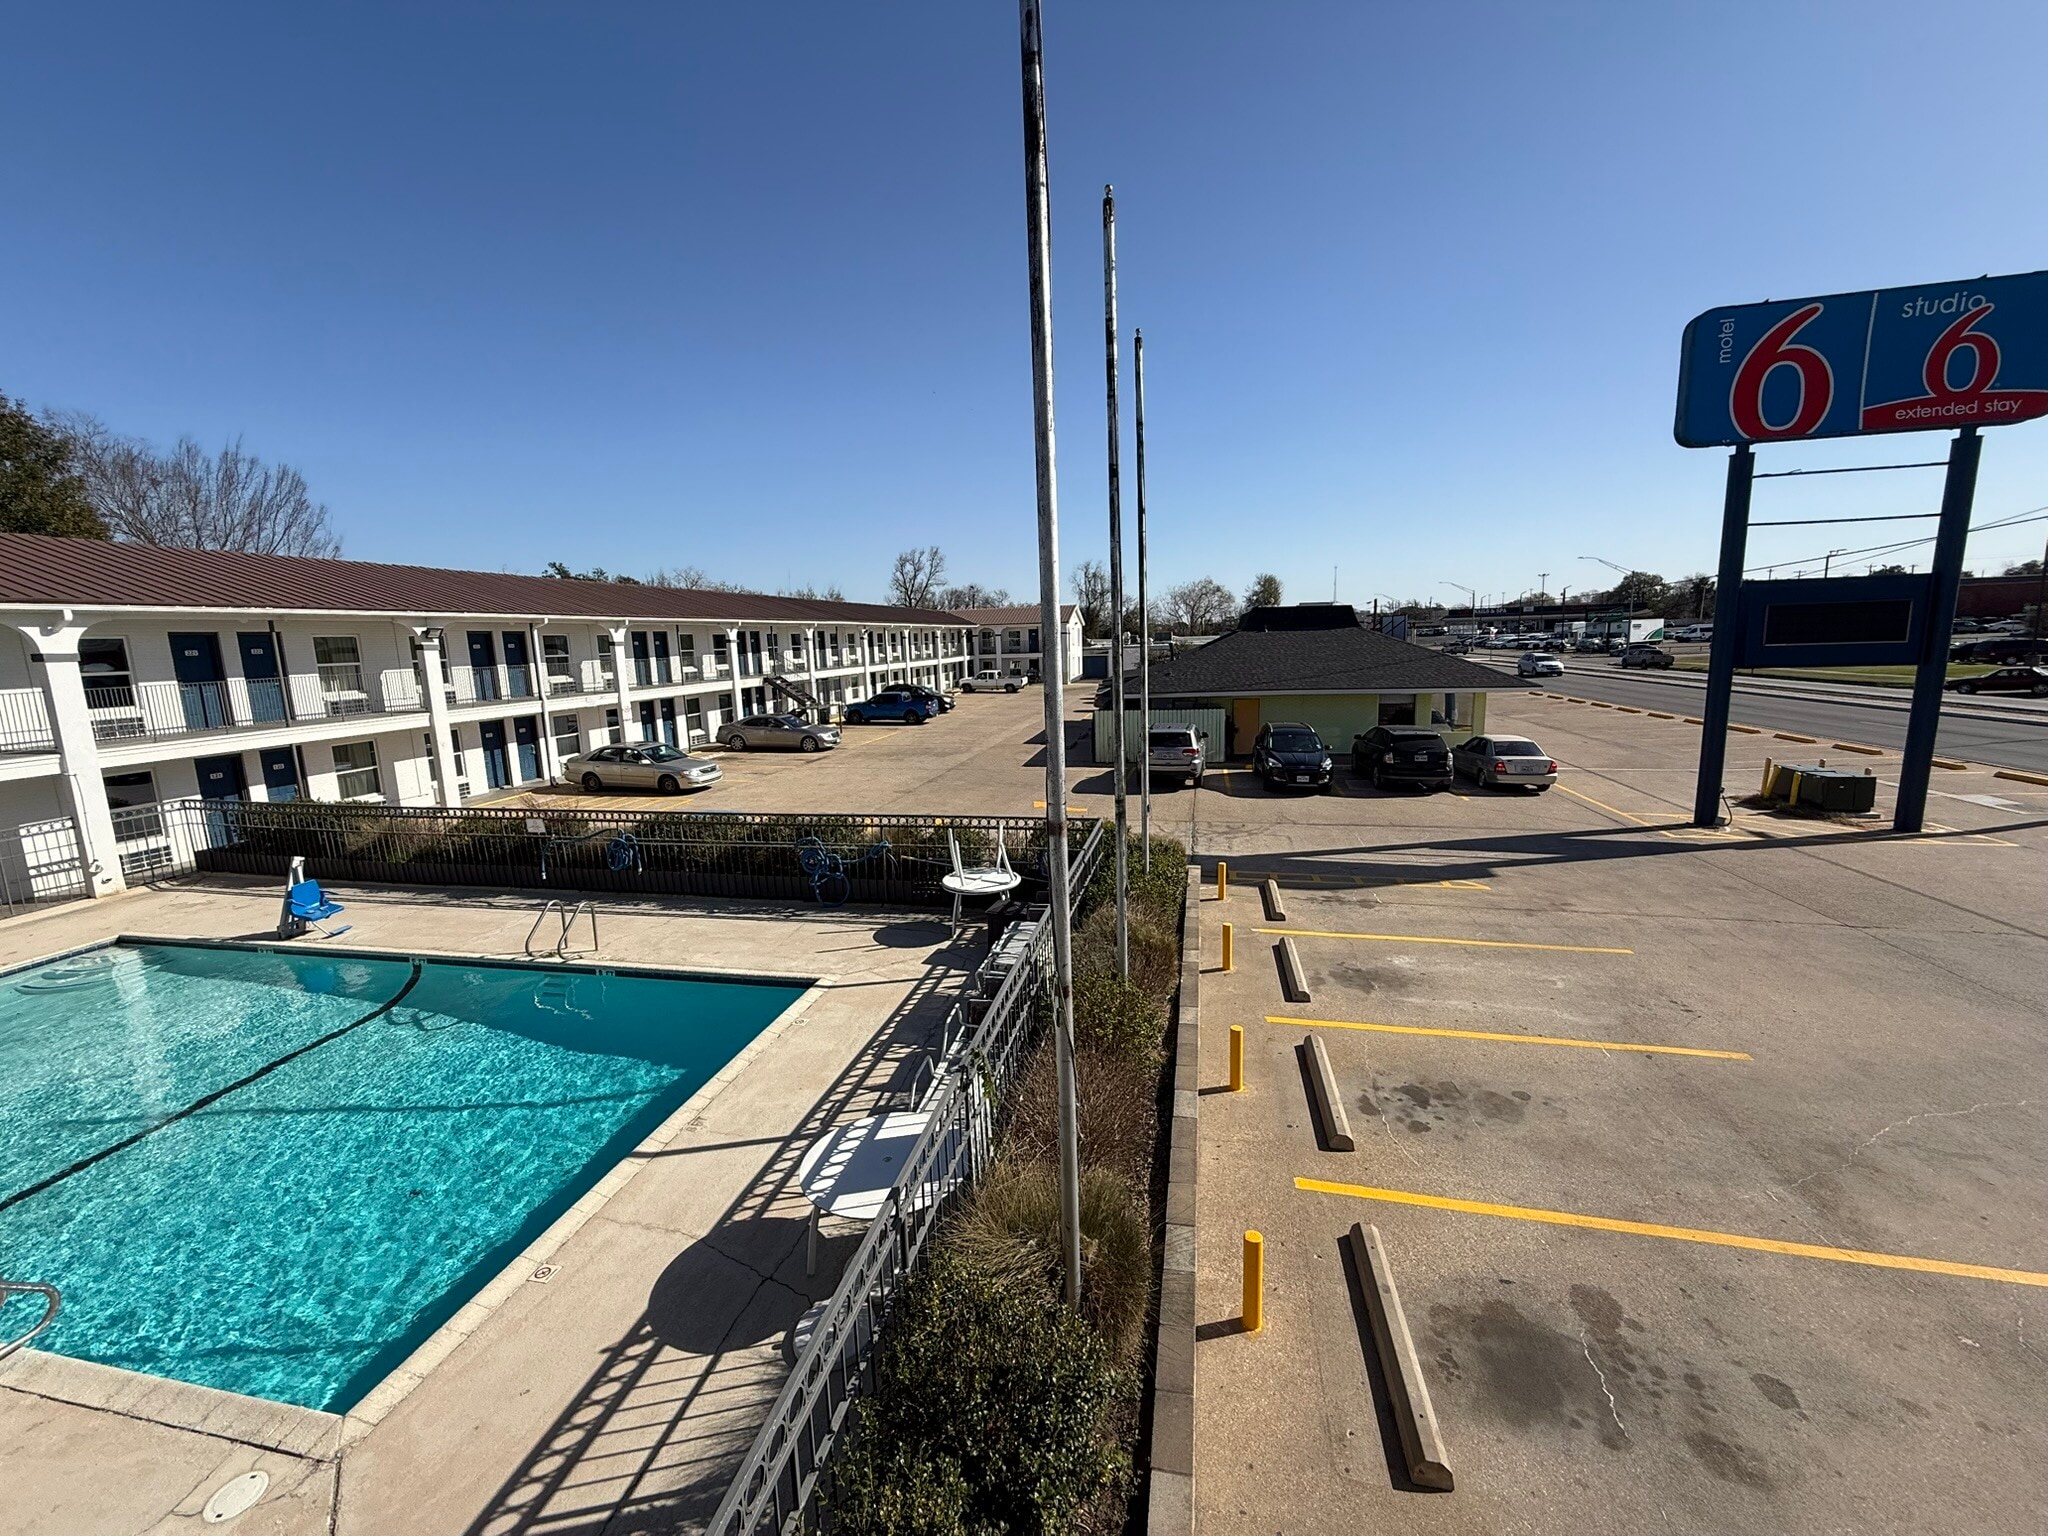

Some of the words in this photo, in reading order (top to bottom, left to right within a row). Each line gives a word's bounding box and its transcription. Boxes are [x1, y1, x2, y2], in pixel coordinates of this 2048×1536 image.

[1902, 291, 1987, 318] studio
[1718, 318, 1736, 363] motel
[1923, 303, 2001, 398] 6
[1729, 303, 1834, 440] 6
[1895, 401, 1978, 420] extended
[1984, 399, 2023, 413] stay
